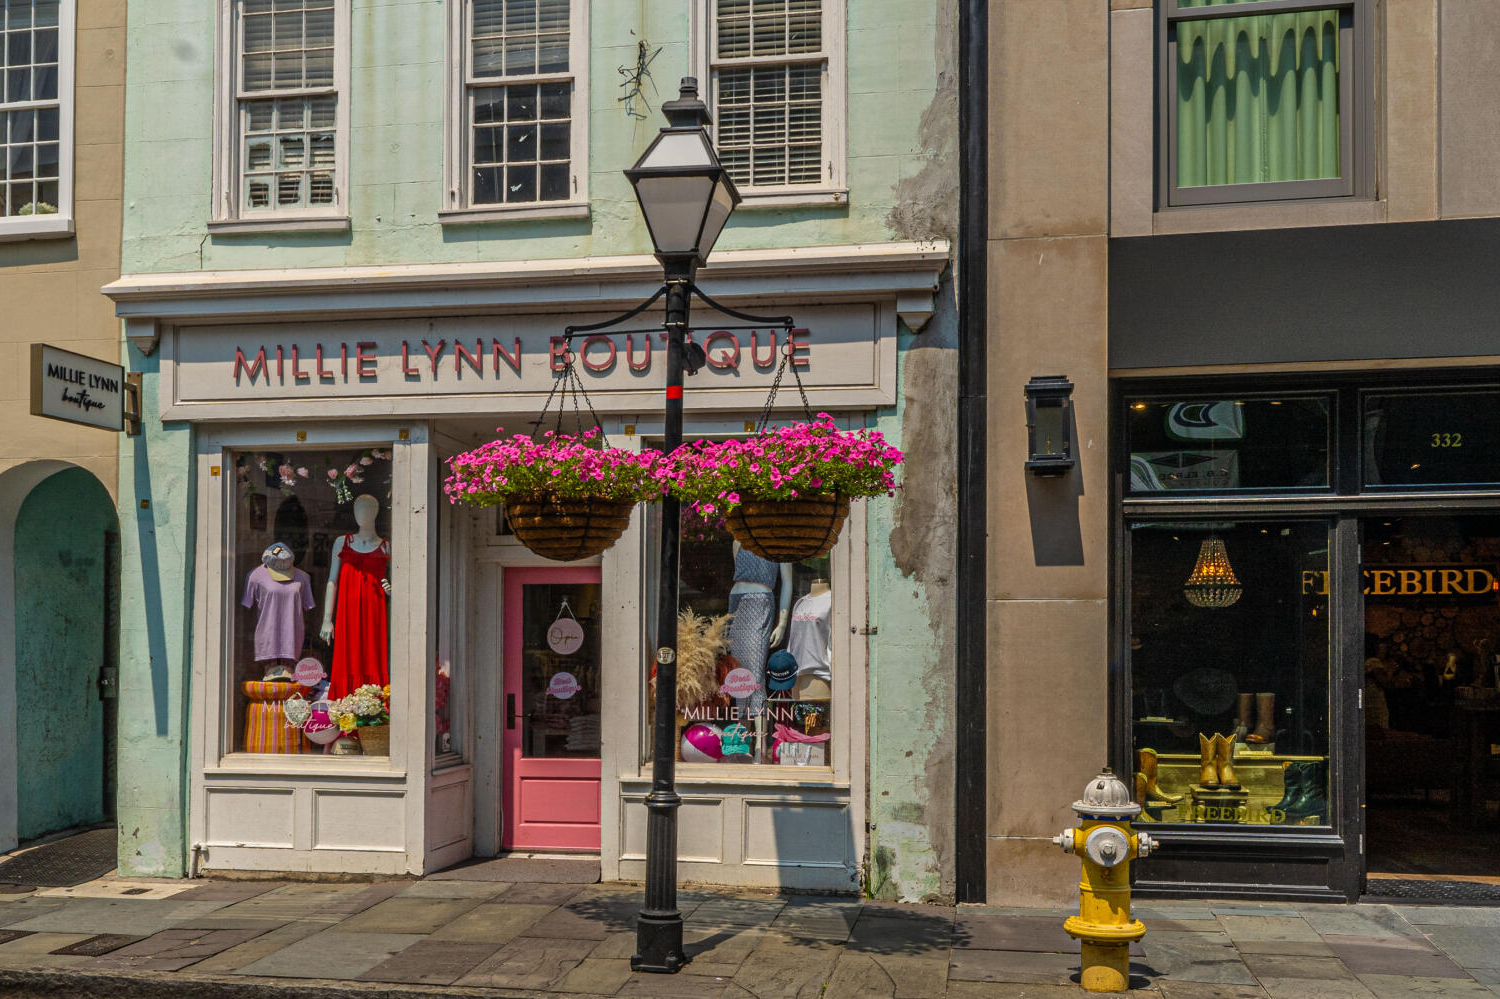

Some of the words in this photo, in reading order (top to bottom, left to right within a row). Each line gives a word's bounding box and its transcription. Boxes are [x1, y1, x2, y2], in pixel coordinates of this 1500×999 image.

[233, 342, 377, 378] MILLIE
[403, 337, 521, 374] LYNN
[550, 329, 810, 371] BOUQUE
[47, 363, 86, 386] MILLIE
[89, 374, 119, 393] LYNN
[62, 387, 106, 412] boutique
[1431, 433, 1462, 448] 332
[1302, 569, 1494, 595] FEBIRD
[684, 706, 739, 721] MILLIE
[747, 706, 794, 721] LYNN
